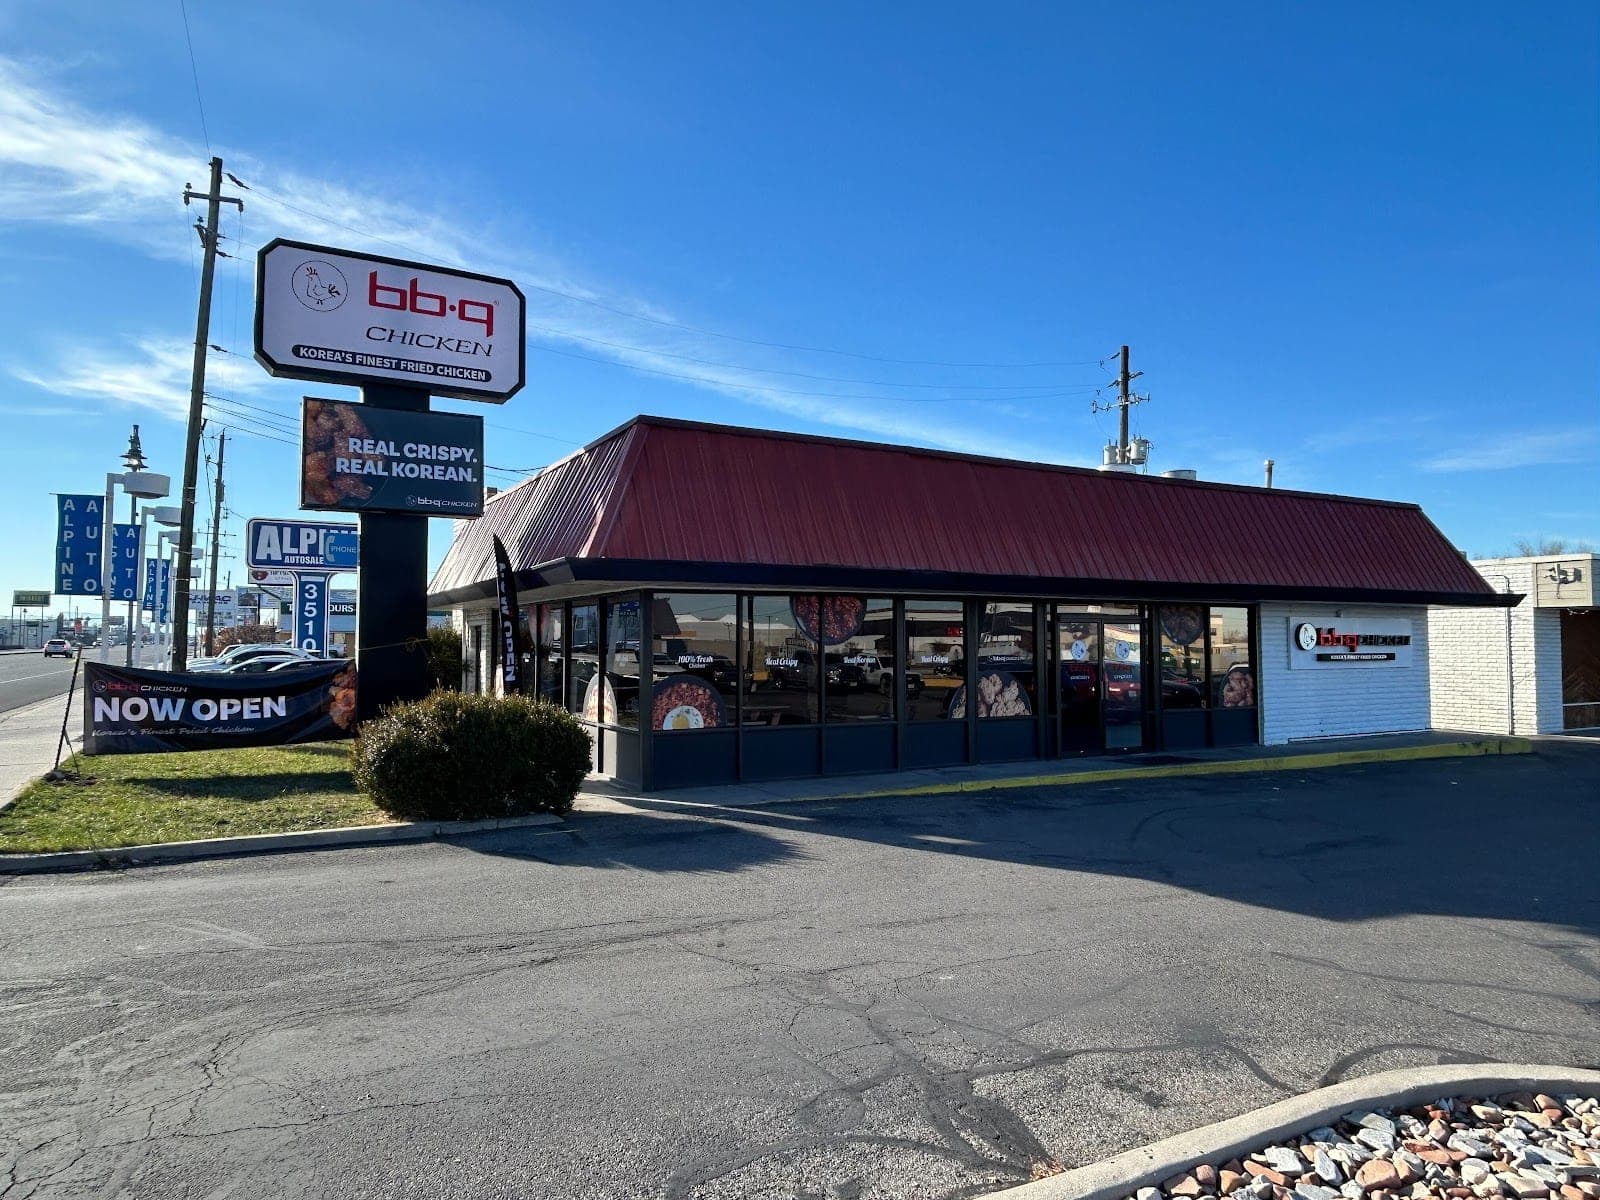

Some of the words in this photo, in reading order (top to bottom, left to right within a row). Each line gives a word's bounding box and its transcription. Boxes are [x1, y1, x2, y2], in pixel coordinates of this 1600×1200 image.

[365, 326, 493, 357] CHICKEN
[300, 346, 353, 364] KOREA'S
[356, 354, 397, 369] FINEST
[400, 359, 434, 374] FRIED
[436, 365, 486, 381] CHICKEN
[348, 437, 400, 457] REAL
[403, 442, 478, 463] CRISPY.
[336, 458, 388, 476] REAL
[391, 462, 478, 482] KOREAN.
[62, 499, 75, 591] ALPINE
[84, 500, 98, 592] AUTO
[255, 525, 357, 560] ALPI
[123, 528, 136, 599] AUTO
[145, 560, 155, 609] ALPINE
[303, 584, 318, 652] 3510
[141, 685, 188, 693] CHICKEN
[94, 697, 185, 722] NOW
[191, 696, 286, 721] OPEN
[211, 726, 255, 734] Chicken
